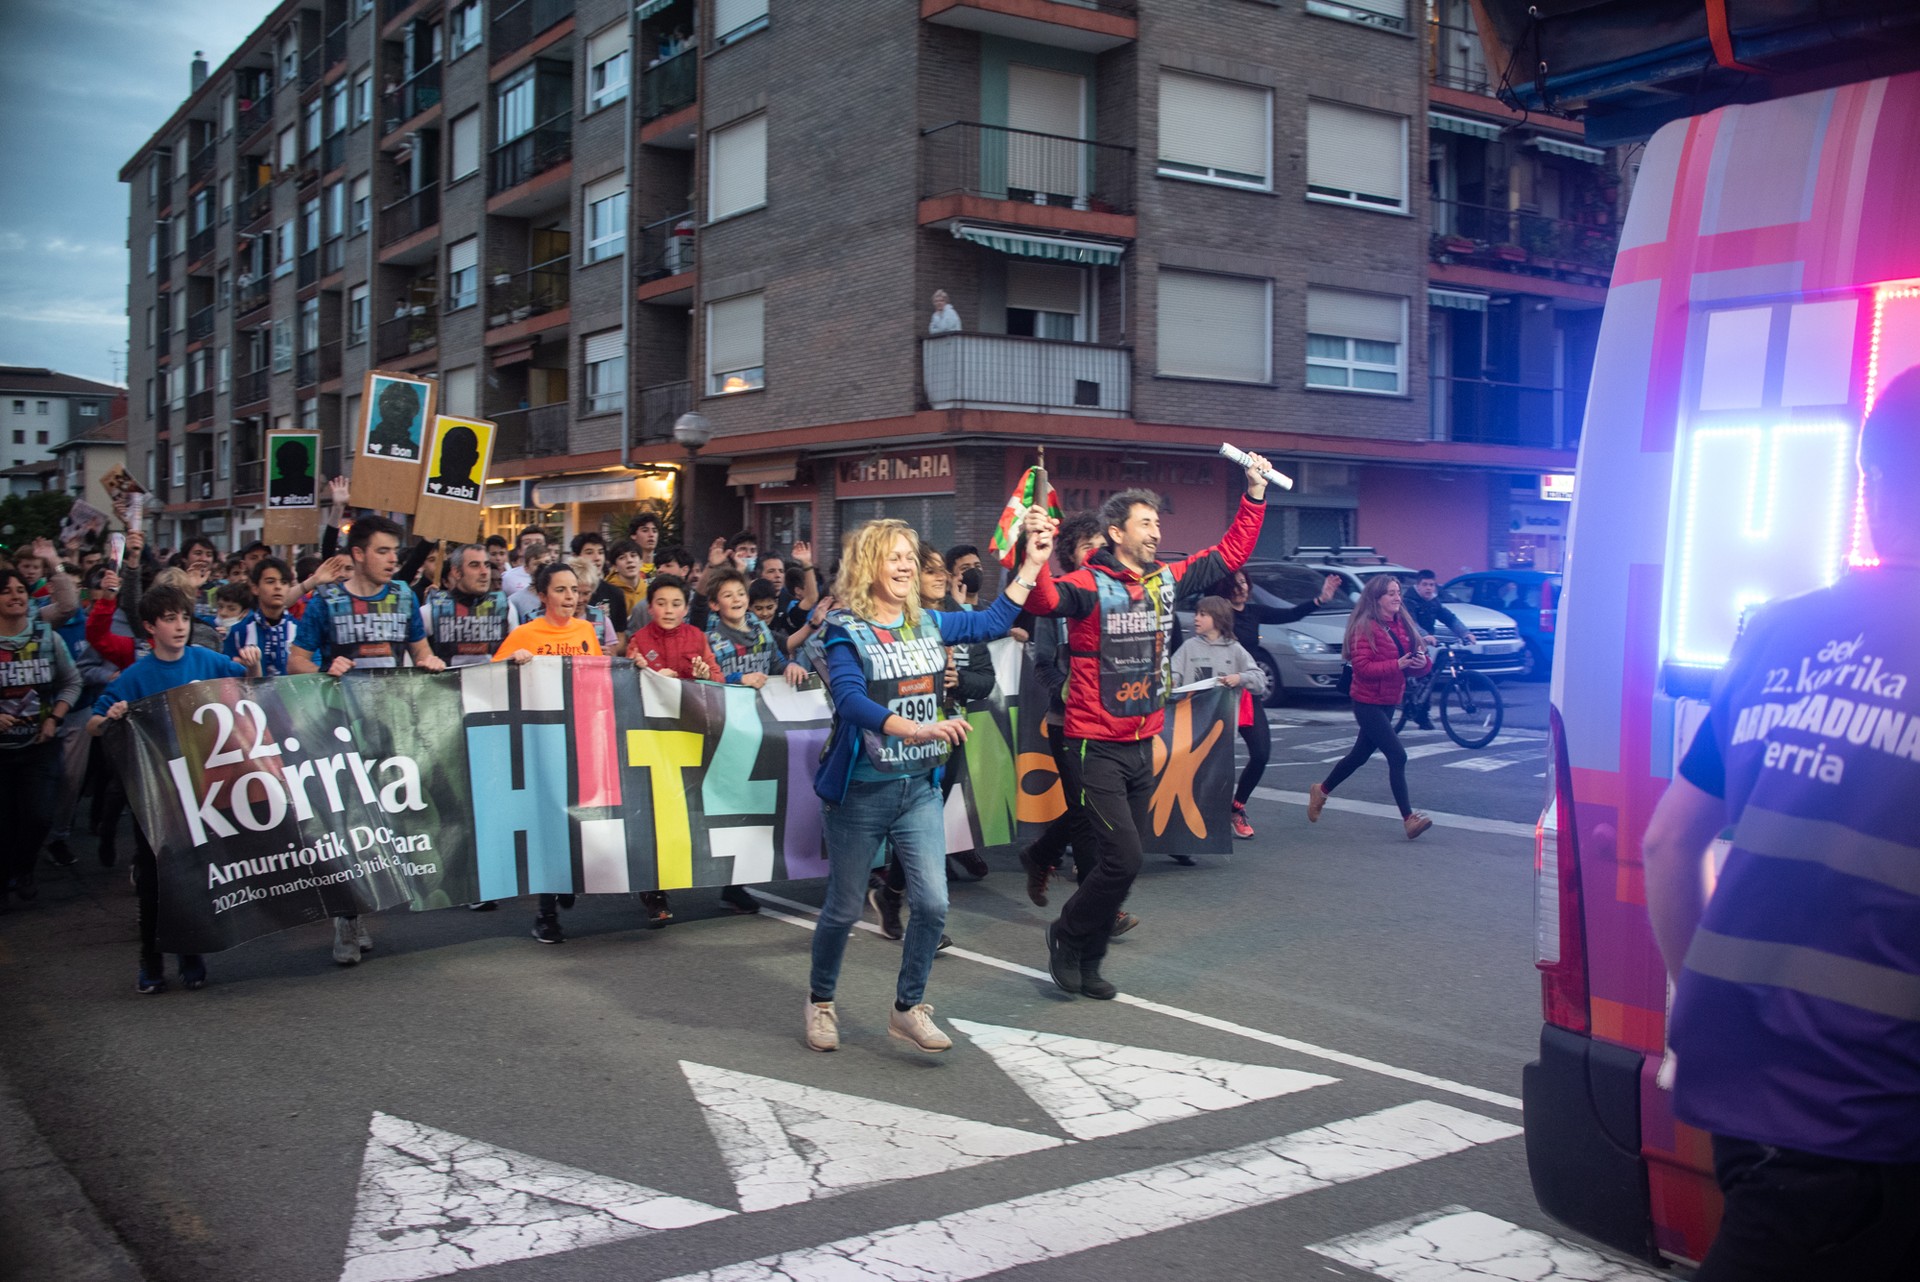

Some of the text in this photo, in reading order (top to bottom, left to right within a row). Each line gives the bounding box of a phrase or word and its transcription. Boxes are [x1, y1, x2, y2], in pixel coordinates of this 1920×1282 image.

[390, 443, 412, 457] ibon
[839, 454, 950, 483] VETERINARIA
[1023, 454, 1214, 485] ABAITARITZA
[282, 493, 313, 505] aitzol
[446, 485, 474, 499] xabi
[865, 637, 946, 681] HITZEKIN
[1116, 675, 1151, 702] aek
[896, 697, 933, 722] 1990
[192, 699, 300, 769] 22.
[207, 832, 350, 889] Amurriotik
[211, 886, 267, 915] 2022ko
[270, 868, 355, 897] martxoaren
[353, 854, 390, 878] 31tik
[401, 861, 437, 877] 10era
